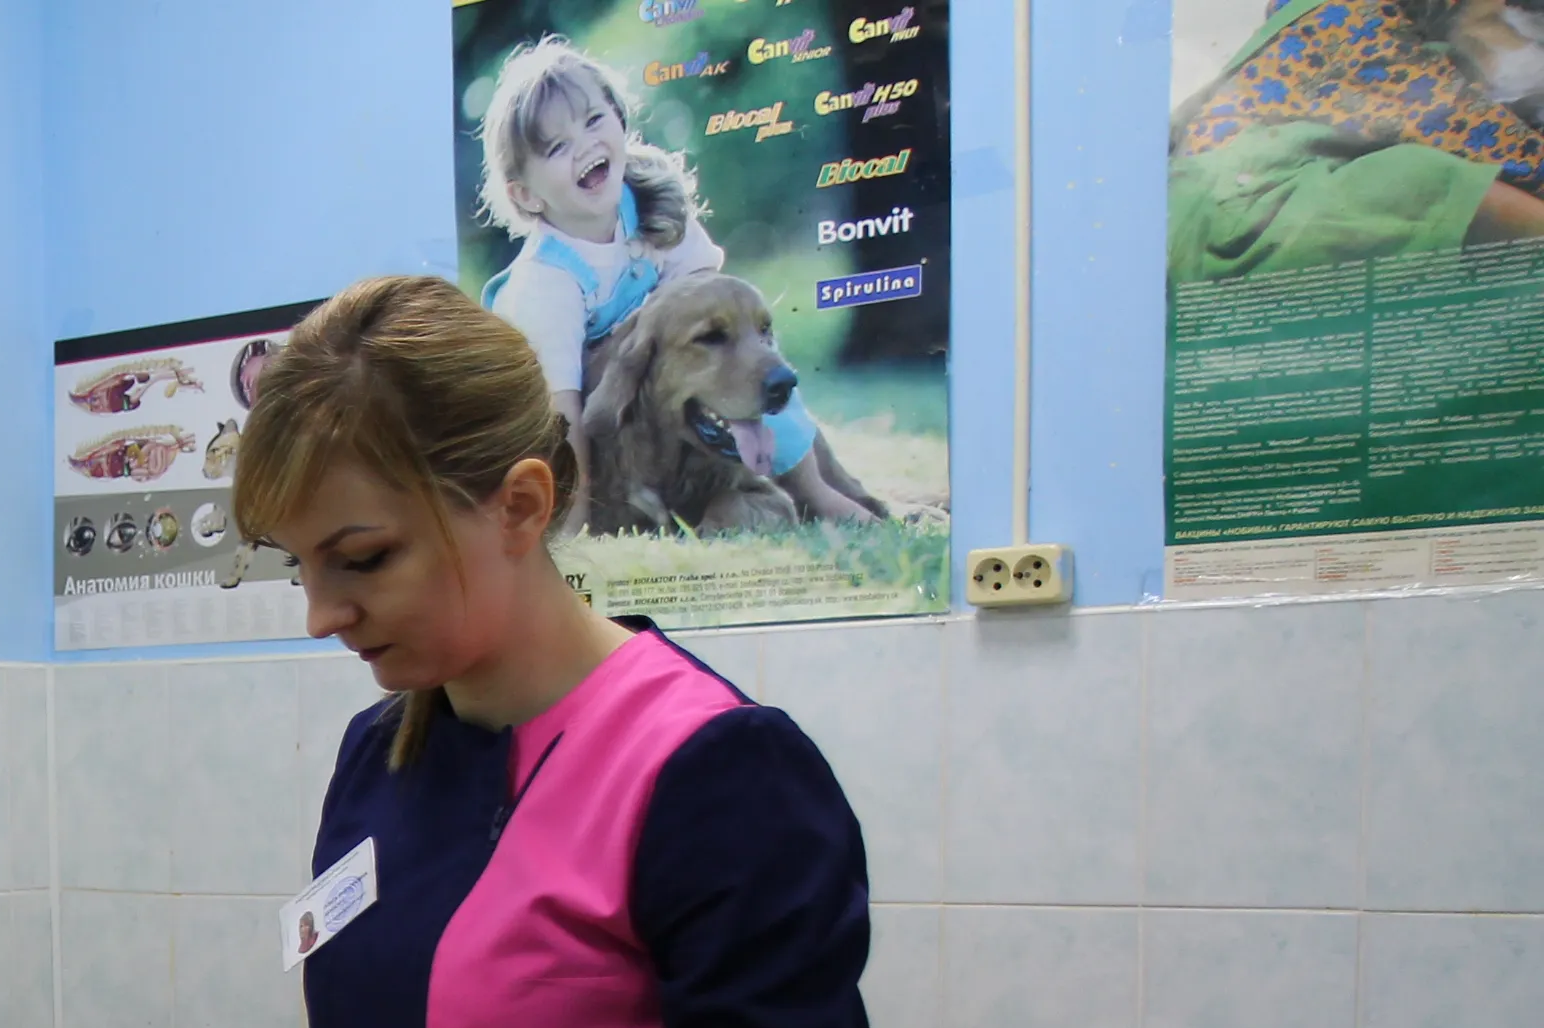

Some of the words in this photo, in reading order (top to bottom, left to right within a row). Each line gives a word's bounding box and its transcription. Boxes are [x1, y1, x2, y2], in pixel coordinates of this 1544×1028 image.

[849, 6, 915, 43] Canvit
[748, 28, 816, 65] Canvit
[791, 46, 832, 63] SENIOR
[700, 61, 730, 77] AK
[873, 79, 918, 104] H50
[705, 101, 785, 136] Biocal
[816, 148, 912, 188] Biocal
[818, 207, 914, 244] Bonvit
[821, 275, 915, 303] Spirulina
[64, 574, 149, 596] Анатомия
[156, 570, 216, 589] кошки
